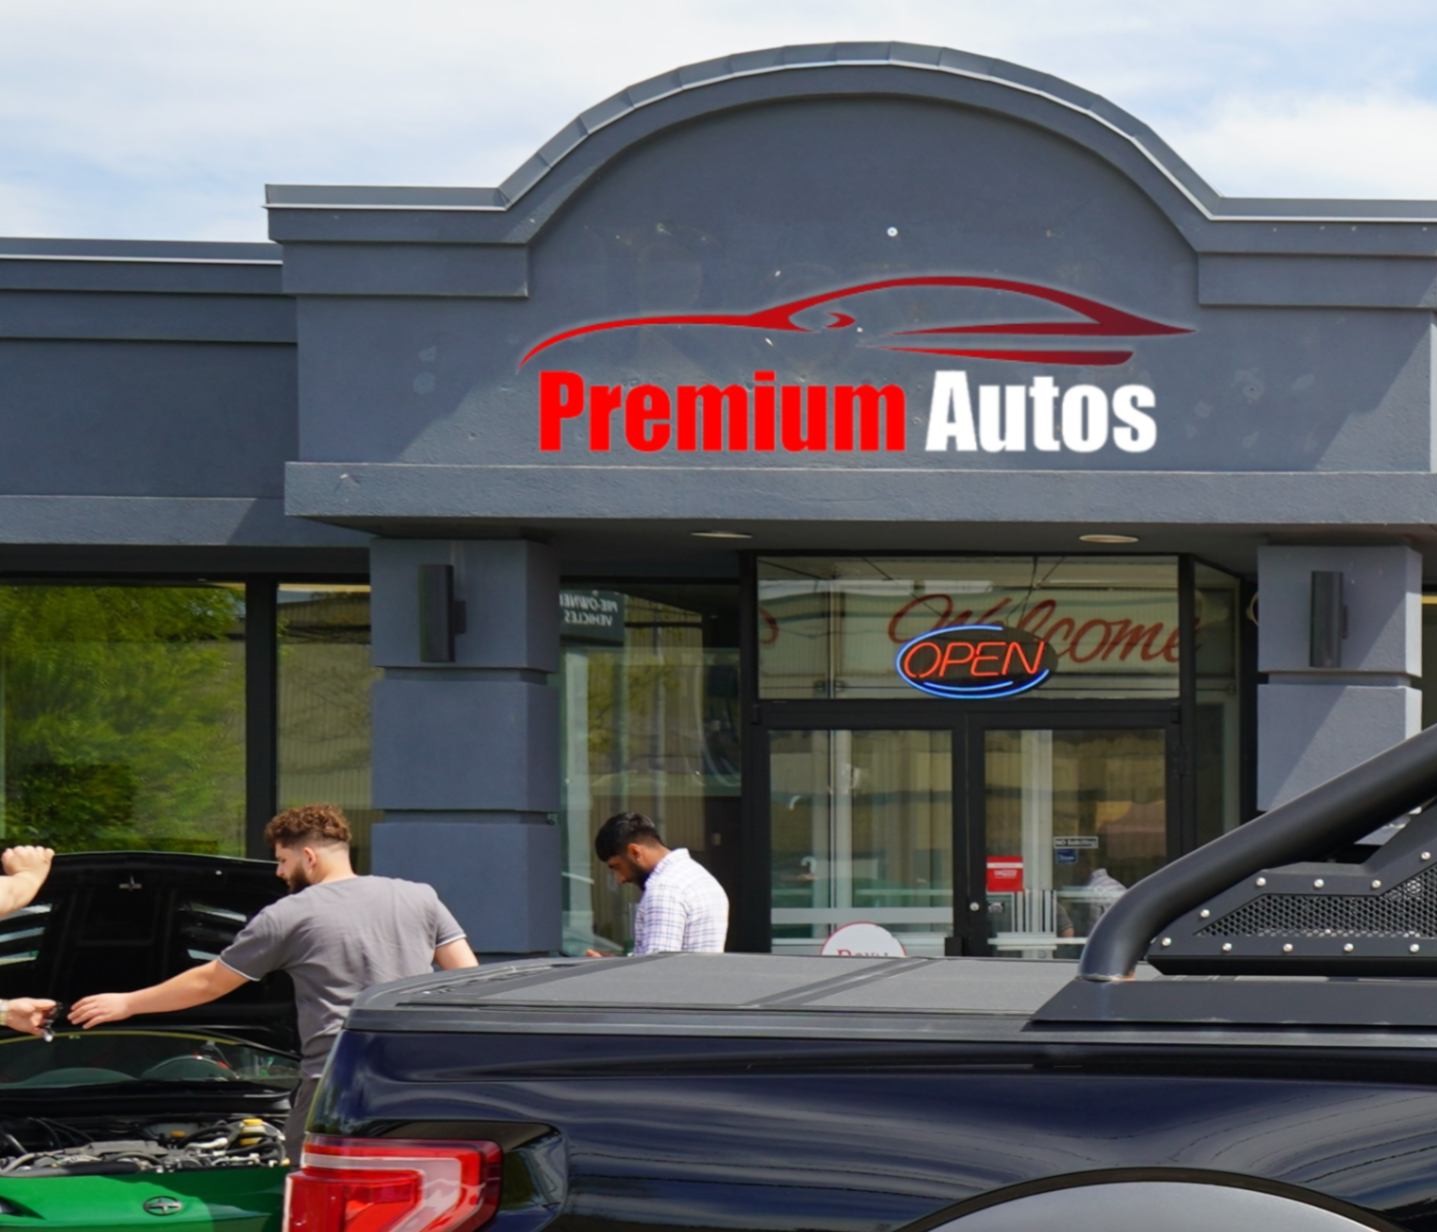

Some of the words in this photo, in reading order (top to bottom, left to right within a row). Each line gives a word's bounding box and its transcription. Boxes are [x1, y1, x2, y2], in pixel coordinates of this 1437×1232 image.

[539, 370, 907, 452] Premium
[925, 370, 1158, 453] Autos
[903, 641, 1045, 679] OPEN
